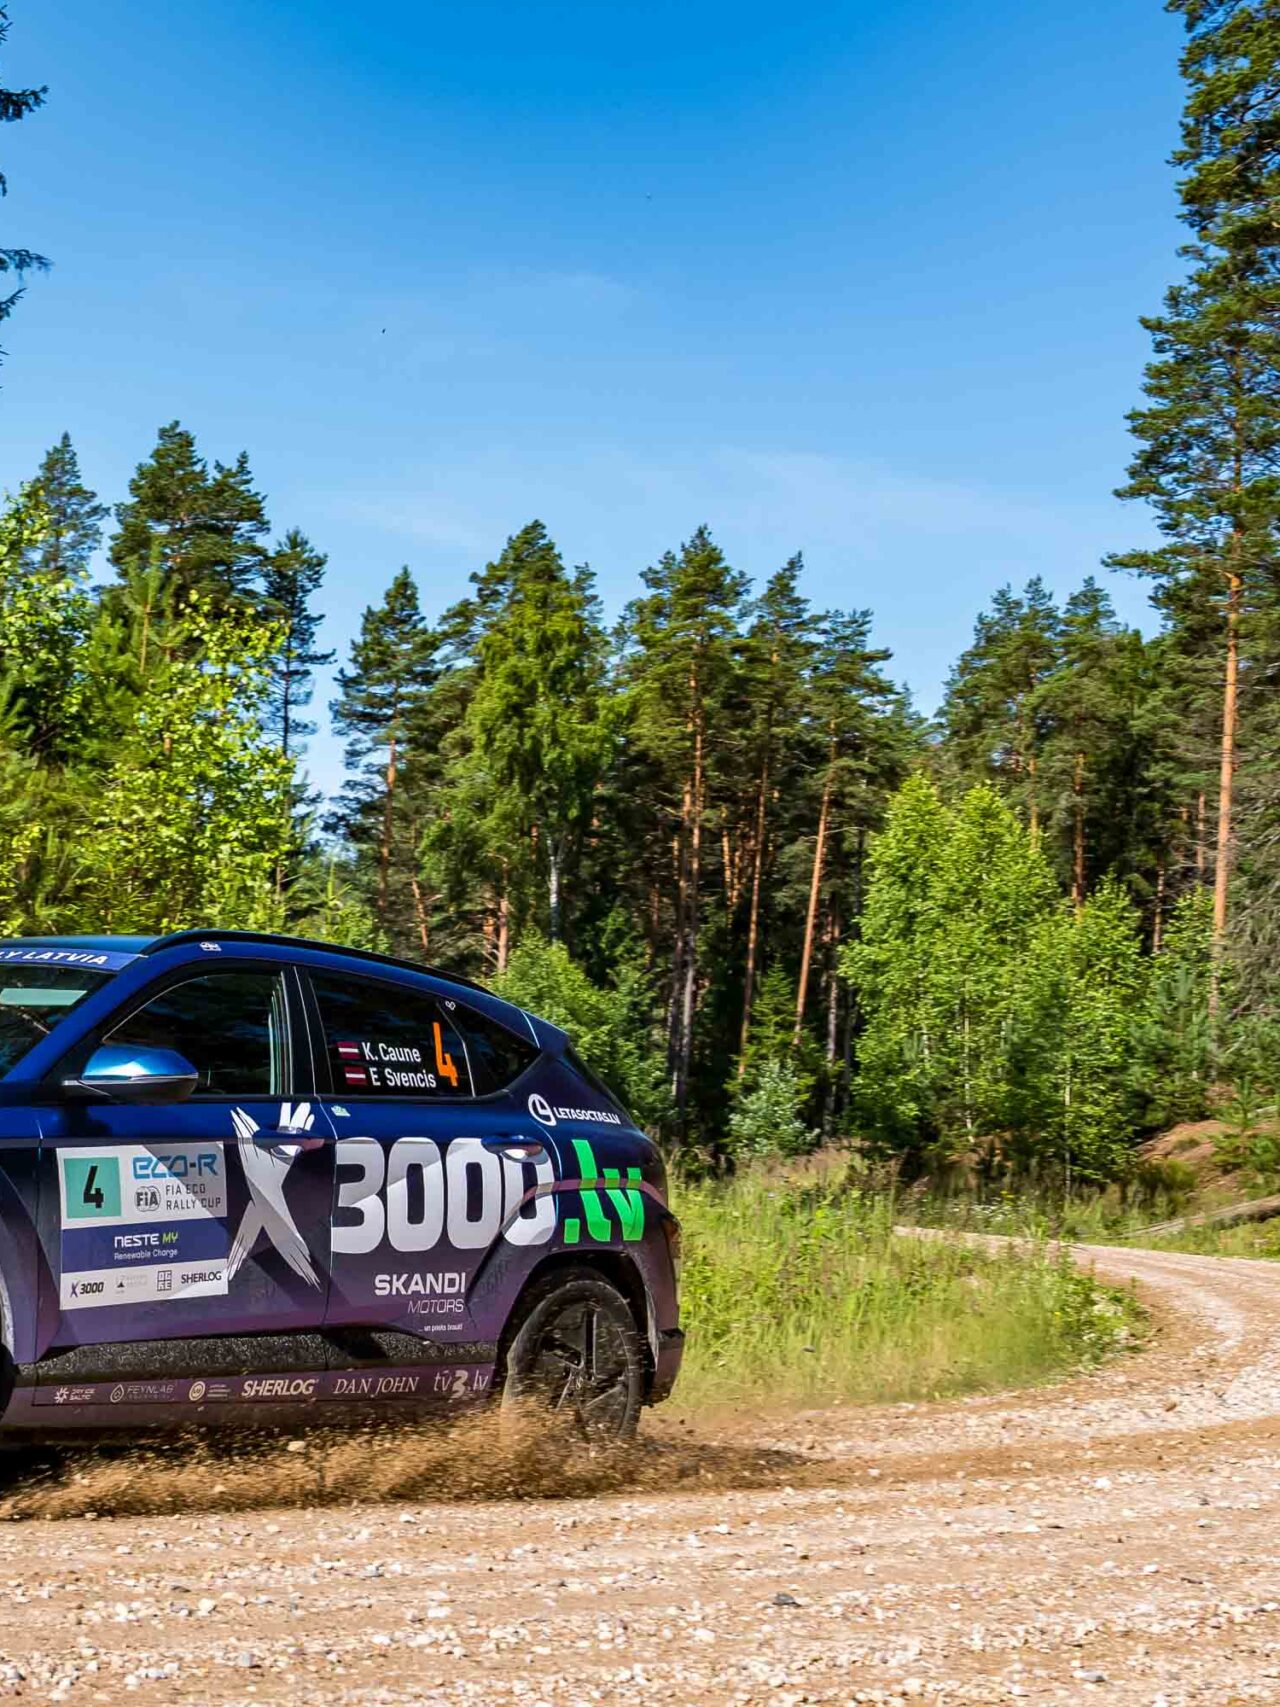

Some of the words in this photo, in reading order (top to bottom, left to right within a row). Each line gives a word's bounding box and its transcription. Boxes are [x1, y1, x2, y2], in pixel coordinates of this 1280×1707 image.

[23, 951, 107, 965] LATVIA
[361, 1042, 378, 1061] K.
[378, 1042, 422, 1062] Caune
[433, 1022, 458, 1087] 4
[384, 1068, 437, 1088] Svencis
[83, 1165, 105, 1209] 4
[165, 1186, 182, 1196] FIA
[186, 1183, 206, 1195] ECO
[166, 1200, 197, 1211] RALLY
[201, 1197, 222, 1209] CUP
[114, 1233, 160, 1248] NESTE
[162, 1231, 179, 1244] MY
[114, 1250, 151, 1260] Renewable
[152, 1248, 178, 1258] Charge
[181, 1270, 222, 1285] SHERLOG
[374, 1272, 466, 1296] SKANDI
[408, 1298, 464, 1314] MOTORS
[241, 1378, 315, 1397] SHERLOG
[333, 1378, 370, 1395] DAN
[374, 1376, 419, 1397] JOHN
